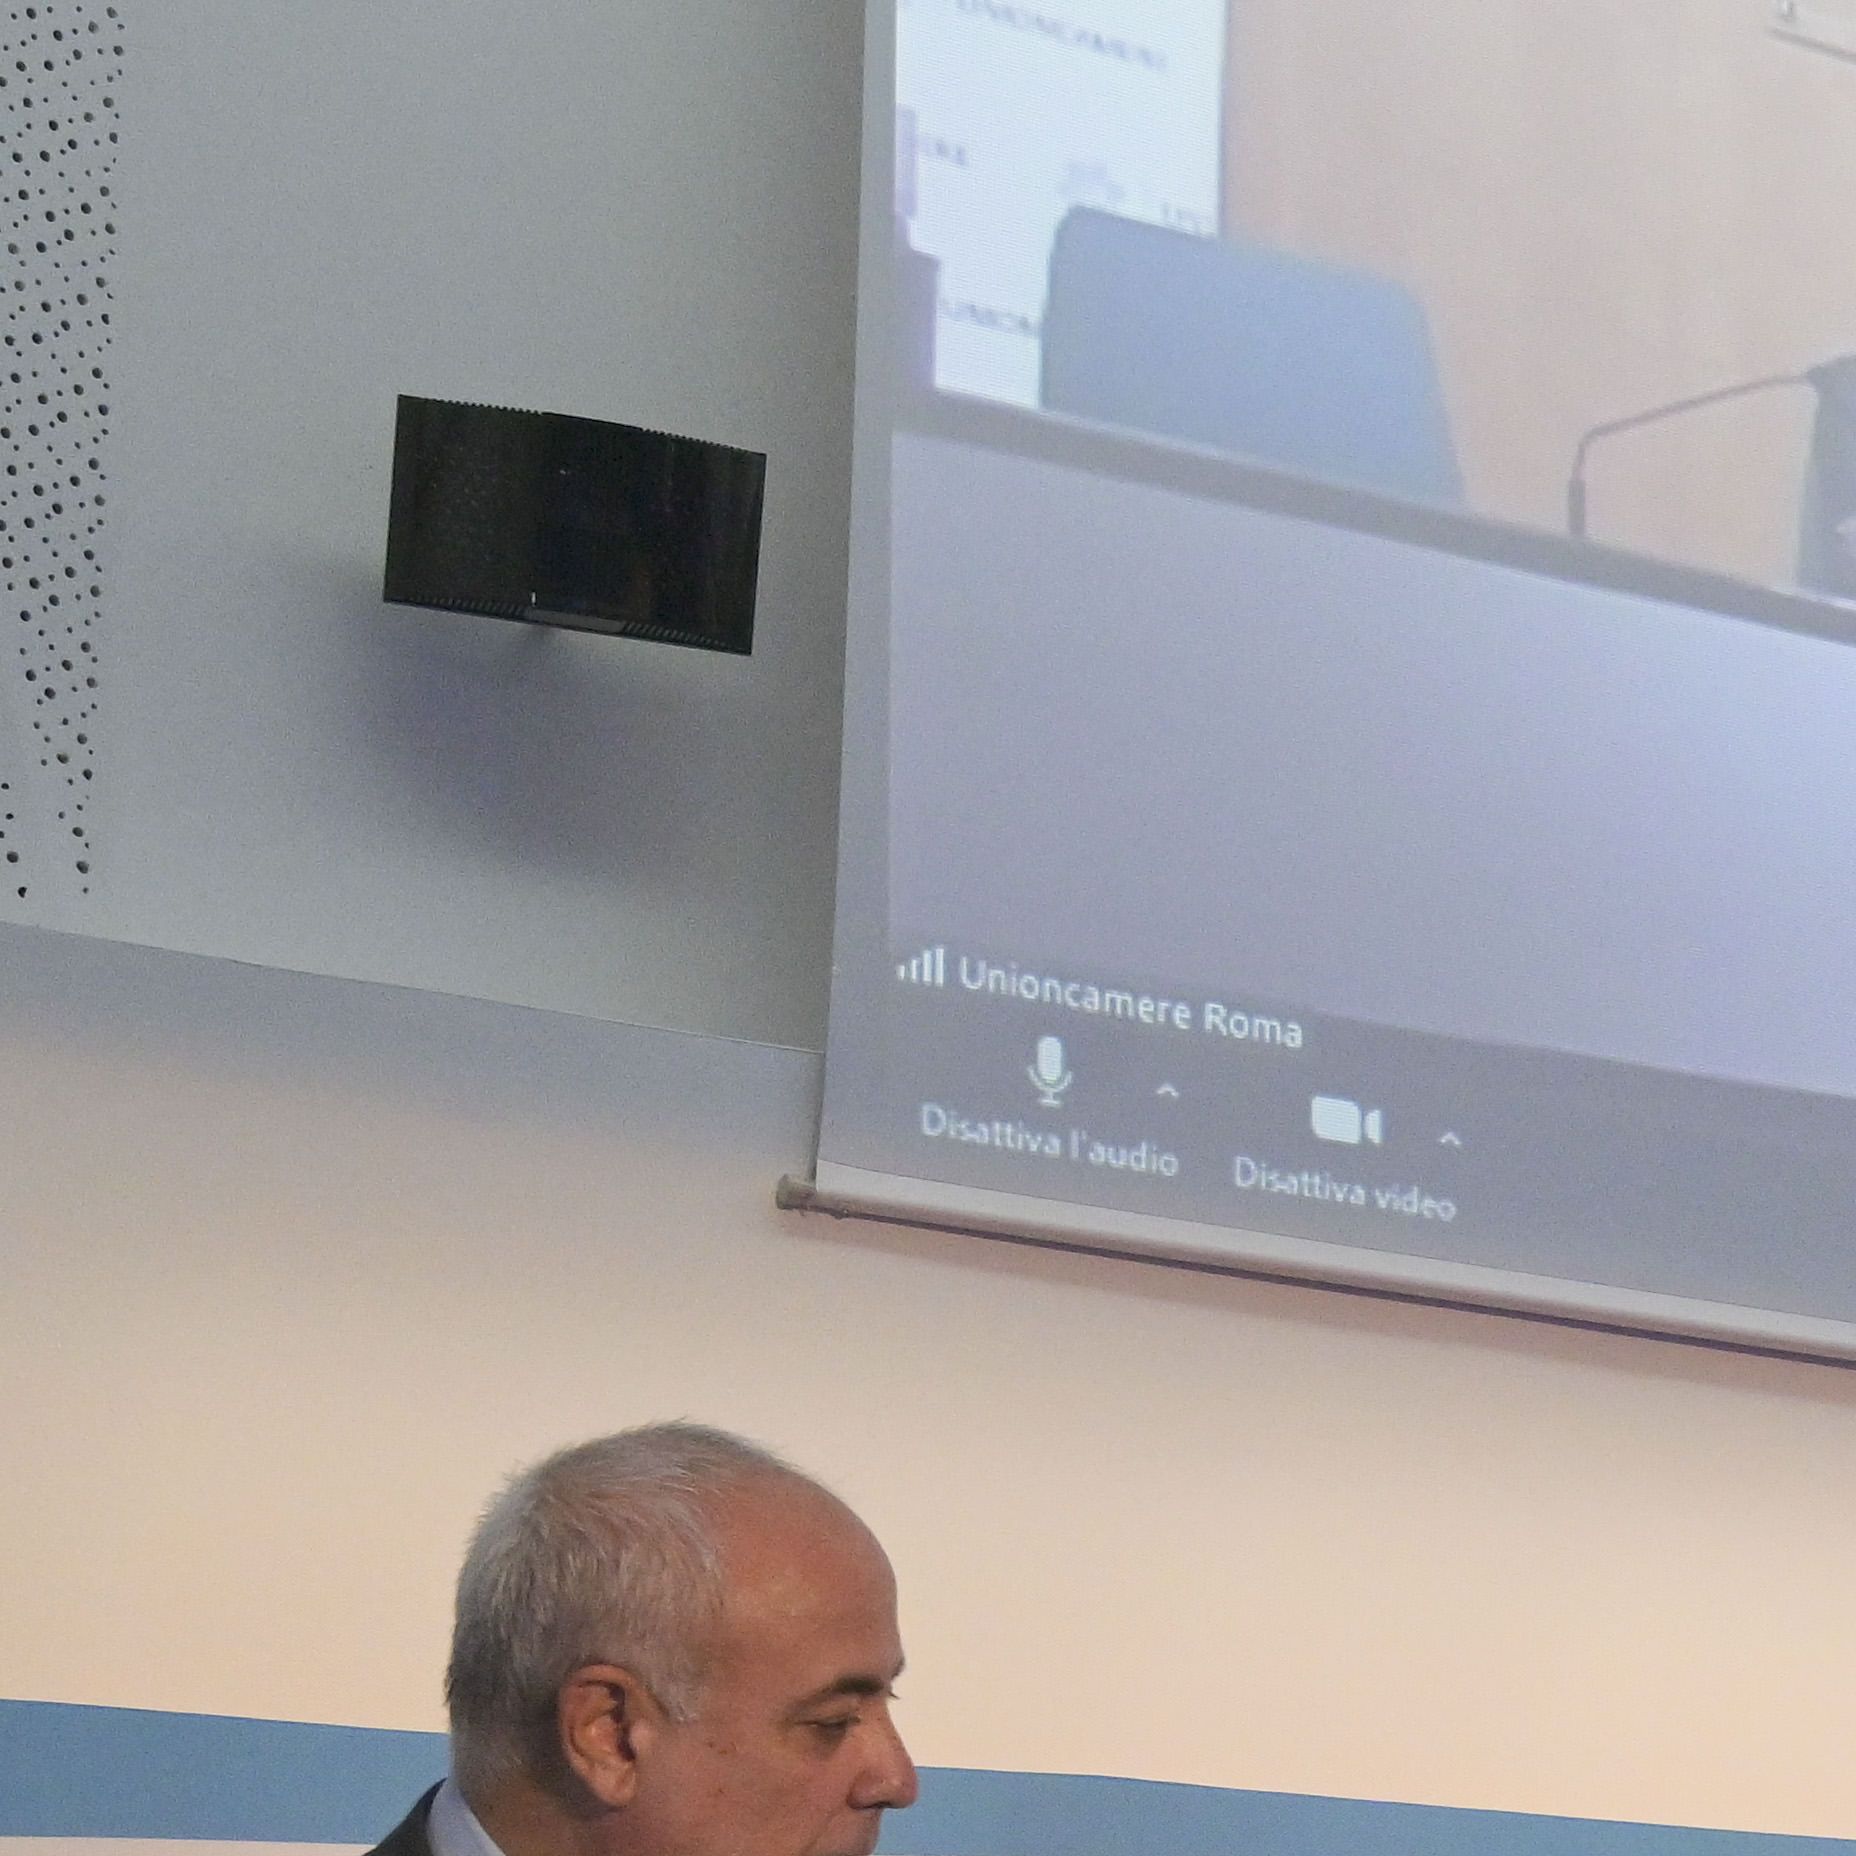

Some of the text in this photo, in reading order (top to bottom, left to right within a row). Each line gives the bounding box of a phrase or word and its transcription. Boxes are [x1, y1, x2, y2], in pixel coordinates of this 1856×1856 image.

[959, 955, 1303, 1049] Unioncamere Roma
[921, 1101, 1179, 1178] Disattiva l'audio
[1234, 1156, 1457, 1223] Disattiva video
